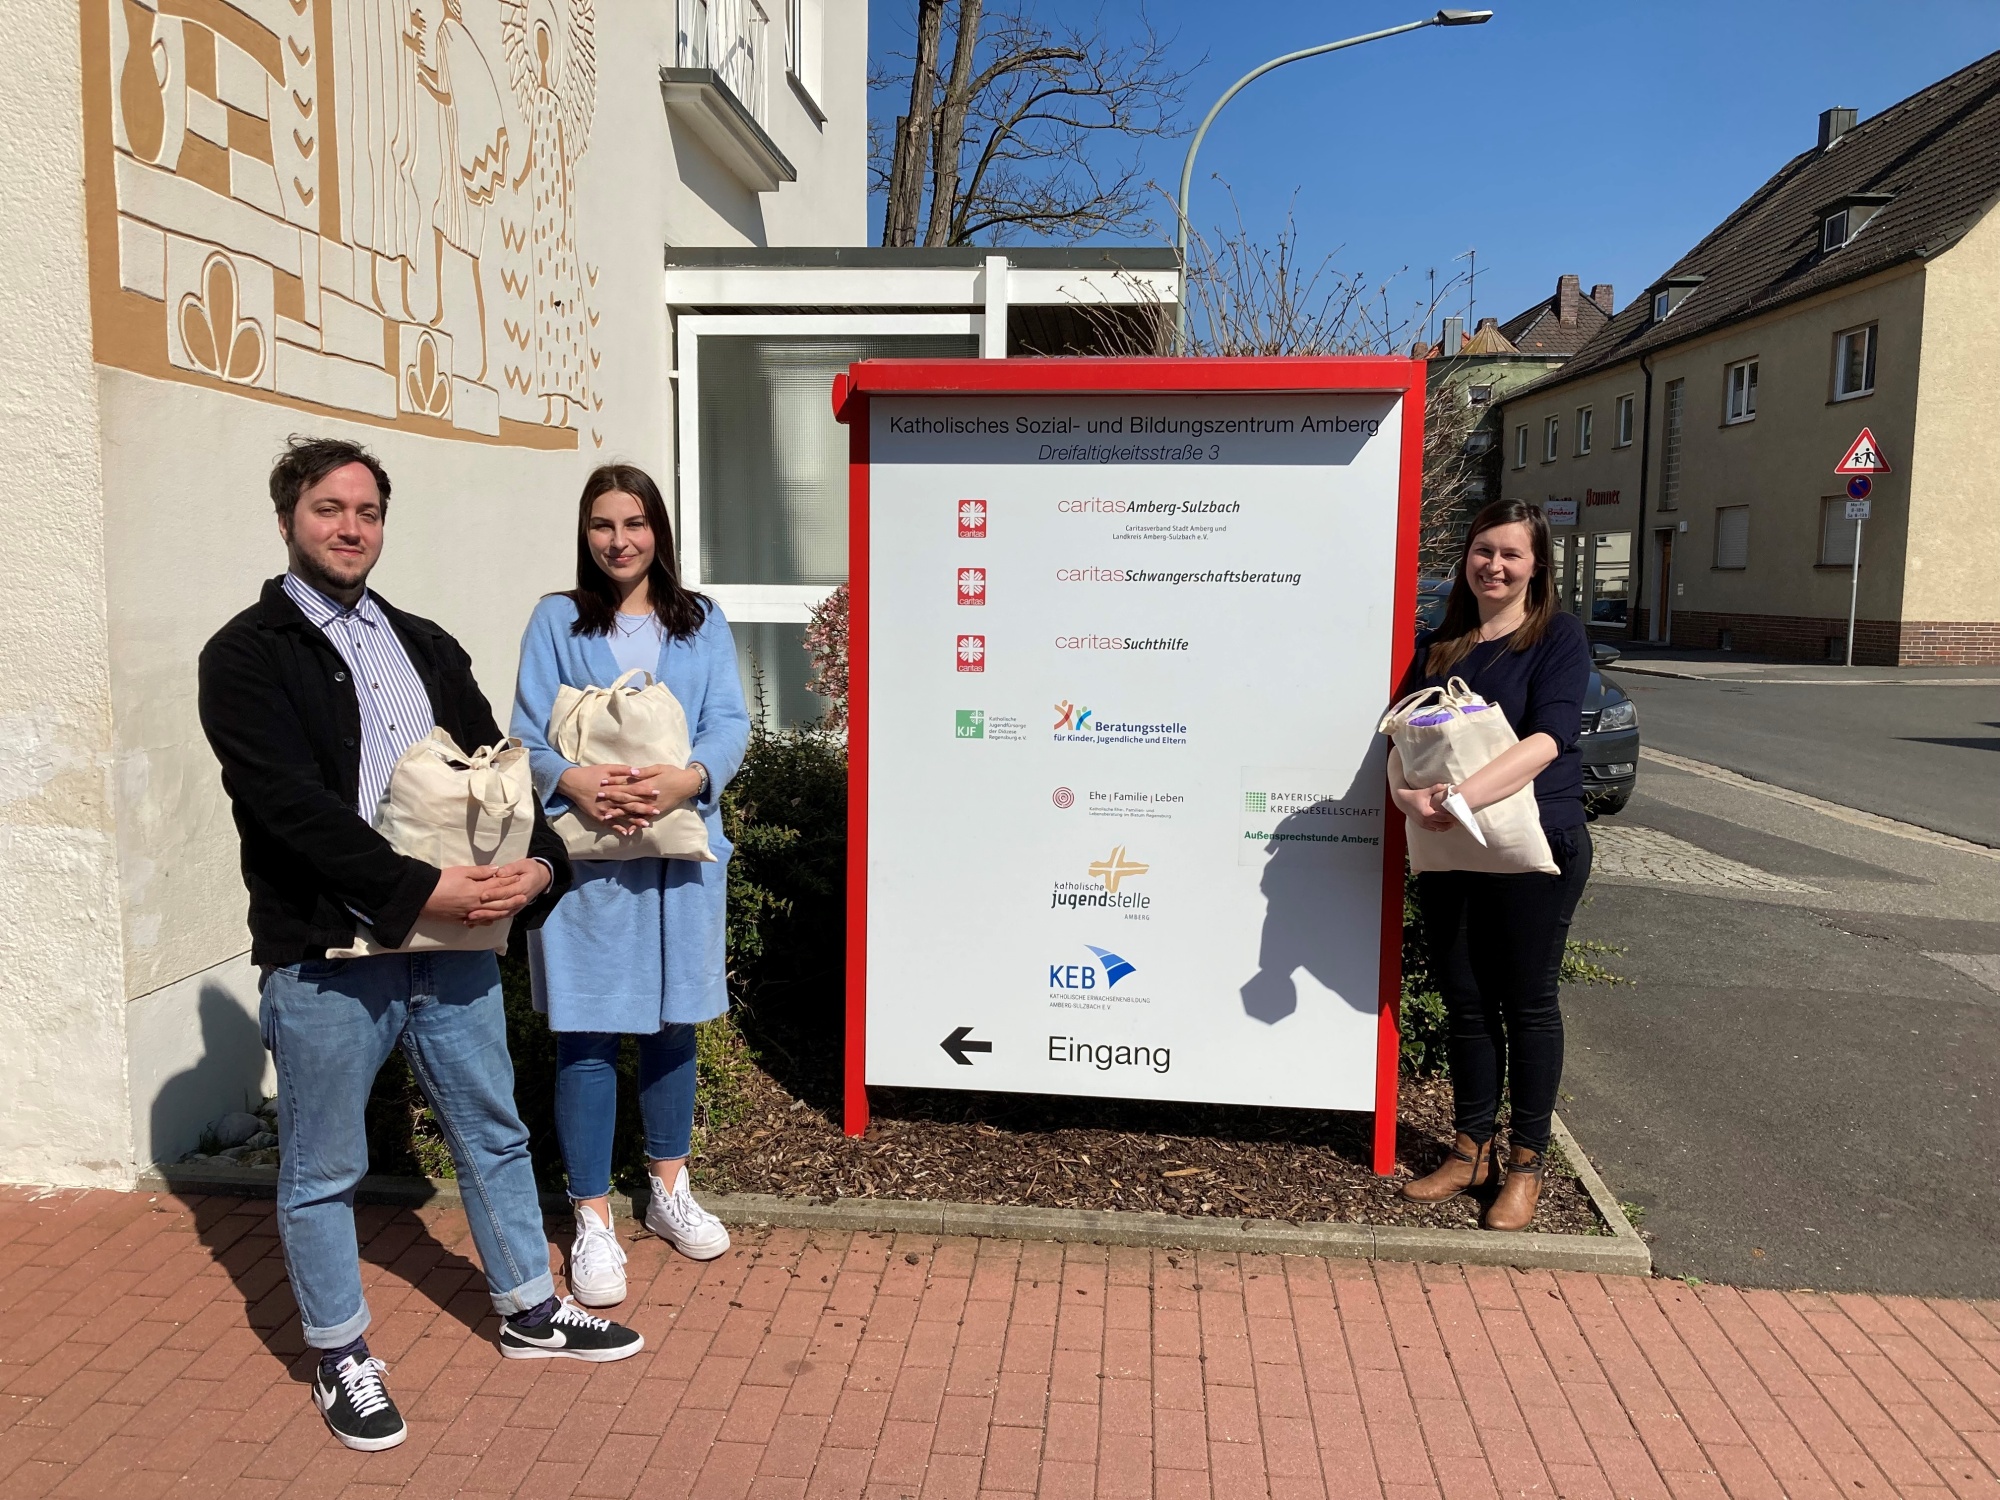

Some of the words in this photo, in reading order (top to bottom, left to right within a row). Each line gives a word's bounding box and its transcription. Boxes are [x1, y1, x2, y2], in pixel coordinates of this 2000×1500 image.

[890, 416, 1010, 434] Katholisches
[1015, 416, 1081, 434] Sozial-
[1087, 416, 1123, 434] und
[1130, 416, 1294, 438] Bildungszentrum
[1299, 416, 1380, 438] Amberg
[1037, 444, 1204, 464] Dreifaltigkeitsstraße
[1208, 444, 1220, 461] 3
[959, 529, 985, 538] caritas
[1125, 524, 1171, 532] Caritasverband
[1172, 524, 1189, 532] Stadt
[1190, 525, 1214, 533] Amberg
[1143, 533, 1196, 541] Amberg-Sulzbach
[959, 597, 984, 605] caritas
[958, 663, 983, 672] caritas
[957, 726, 976, 737] KJF
[1095, 721, 1187, 735] Beratungsstelle
[1053, 733, 1066, 741] für
[1067, 734, 1096, 743] Kinder,
[1096, 735, 1144, 744] Jugendliche
[1144, 736, 1161, 744] und
[1161, 736, 1187, 744] Eltern
[1089, 791, 1107, 800] Ehe
[1113, 791, 1149, 802] Familie
[1154, 793, 1184, 803] Leben
[1270, 792, 1334, 803] BAYERISCHE
[1270, 805, 1381, 817] KREBSGESELLSCHAFT
[1244, 830, 1339, 843] Außensprechstunde
[1341, 834, 1379, 846] Amberg
[1053, 881, 1105, 892] katholische
[1050, 889, 1151, 910] jugendstelle
[1123, 913, 1151, 921] AMBERG
[1049, 964, 1096, 990] KEB
[1049, 993, 1086, 1001] KATHOLISCHE
[1086, 995, 1151, 1004] ERWACHSENENBILDUNG
[1048, 1035, 1171, 1074] Eingang
